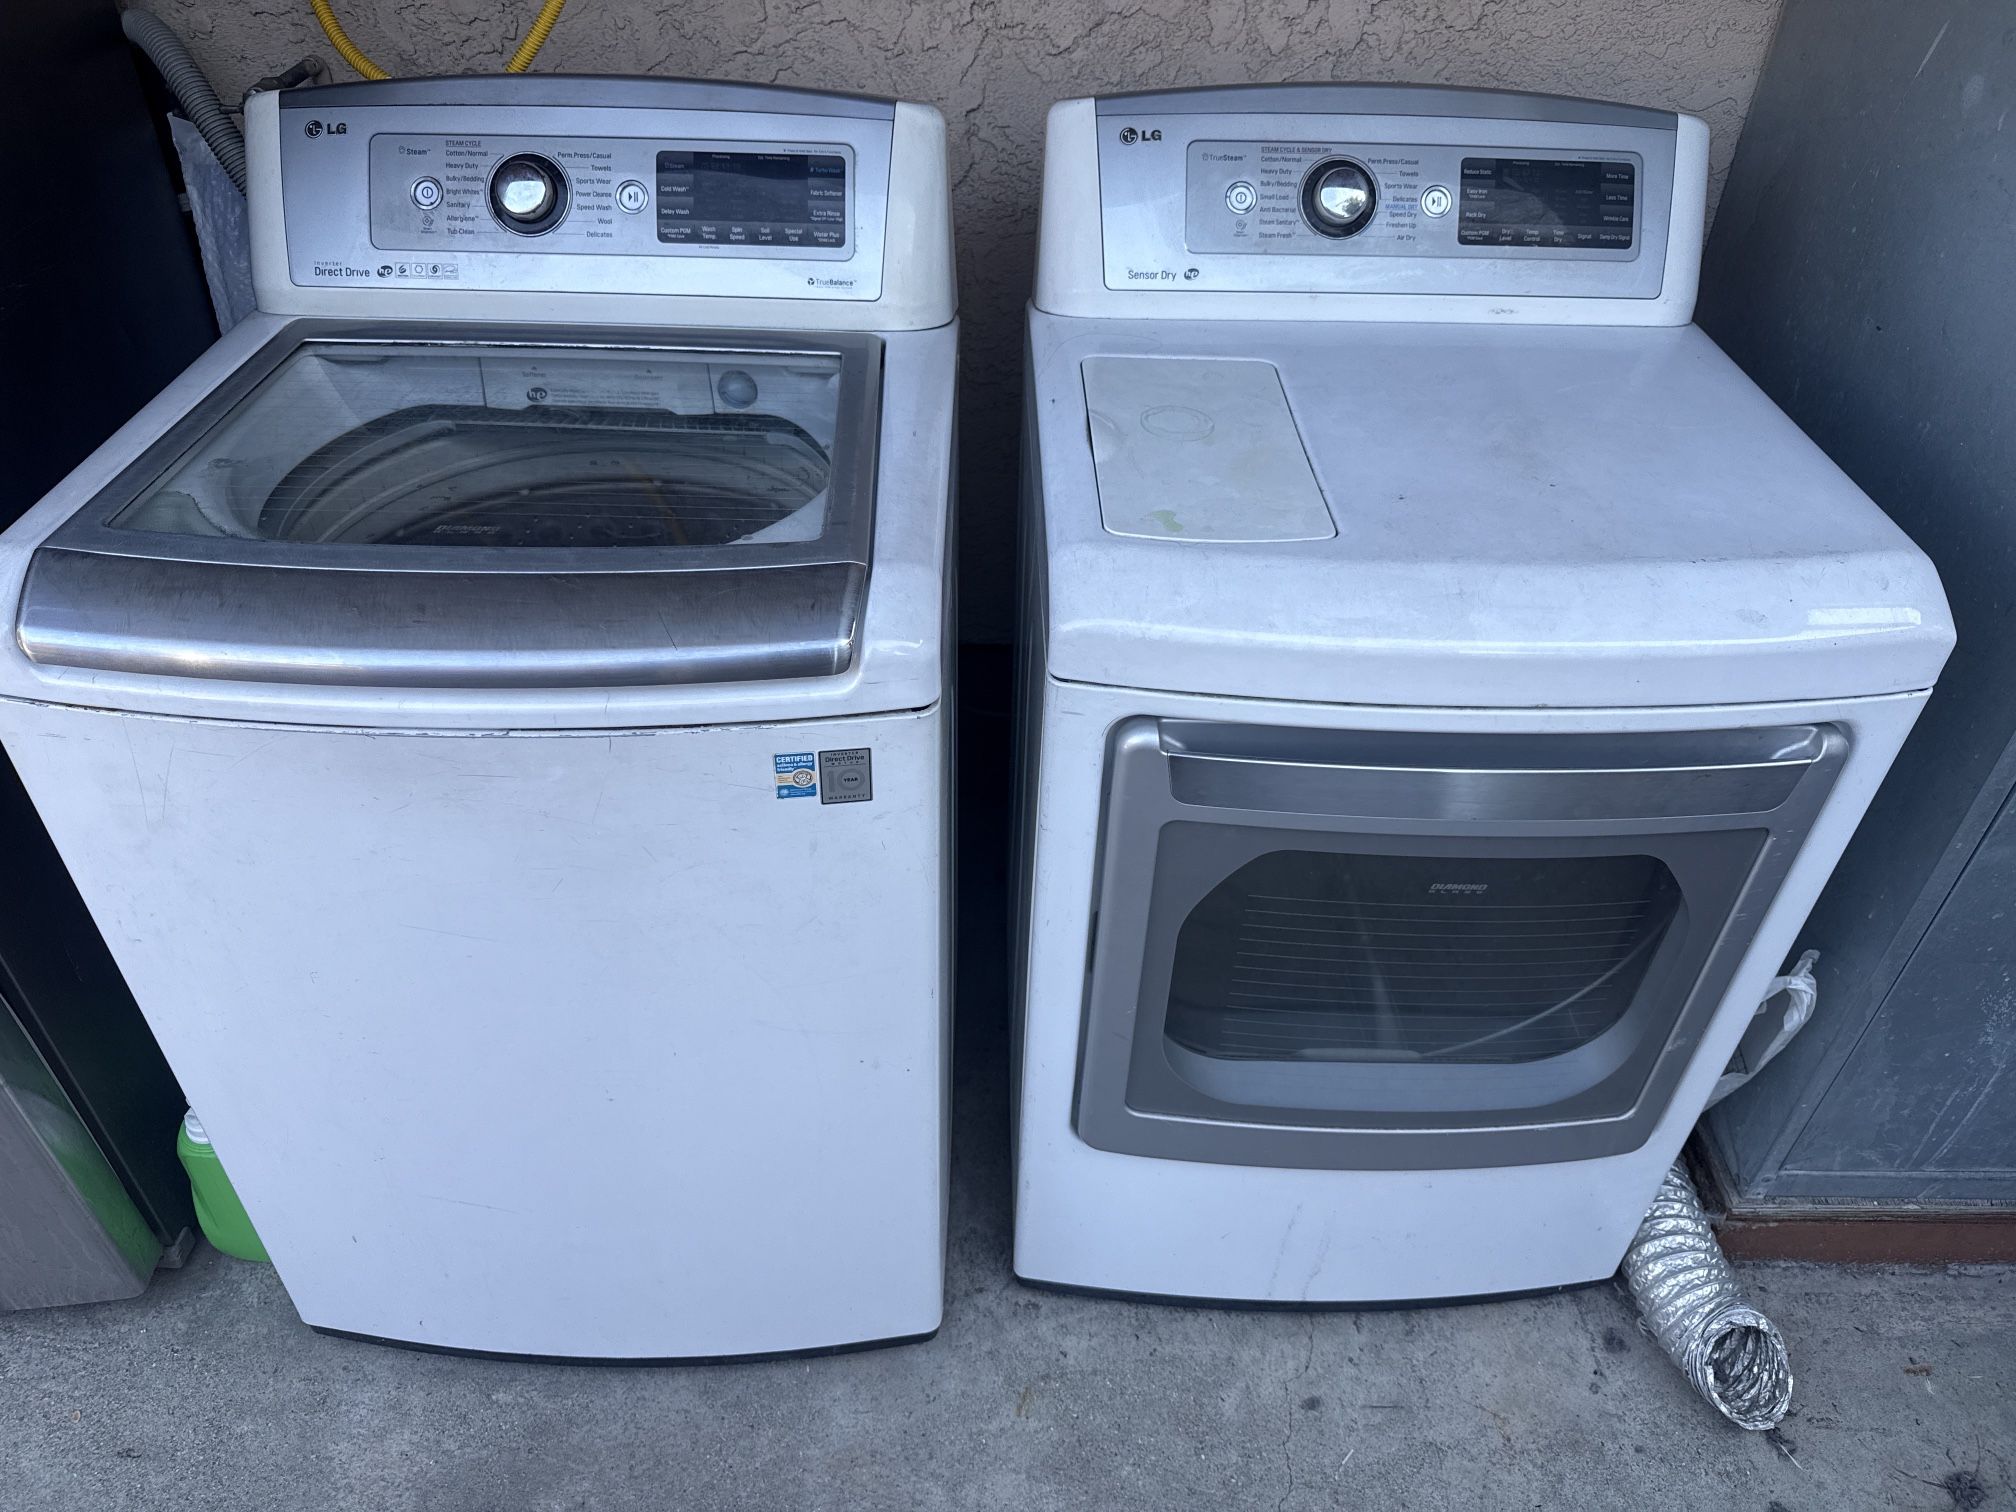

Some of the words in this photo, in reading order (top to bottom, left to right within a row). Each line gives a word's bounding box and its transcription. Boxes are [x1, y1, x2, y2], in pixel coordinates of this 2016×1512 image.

[327, 123, 347, 136] LG
[1141, 130, 1162, 142] LG
[446, 201, 471, 209] Sanitary
[314, 266, 343, 277] Direct
[346, 267, 370, 277] Drive
[1128, 269, 1159, 280] Sensor
[1161, 269, 1177, 282] Dry
[776, 754, 813, 763] CERTIFIED
